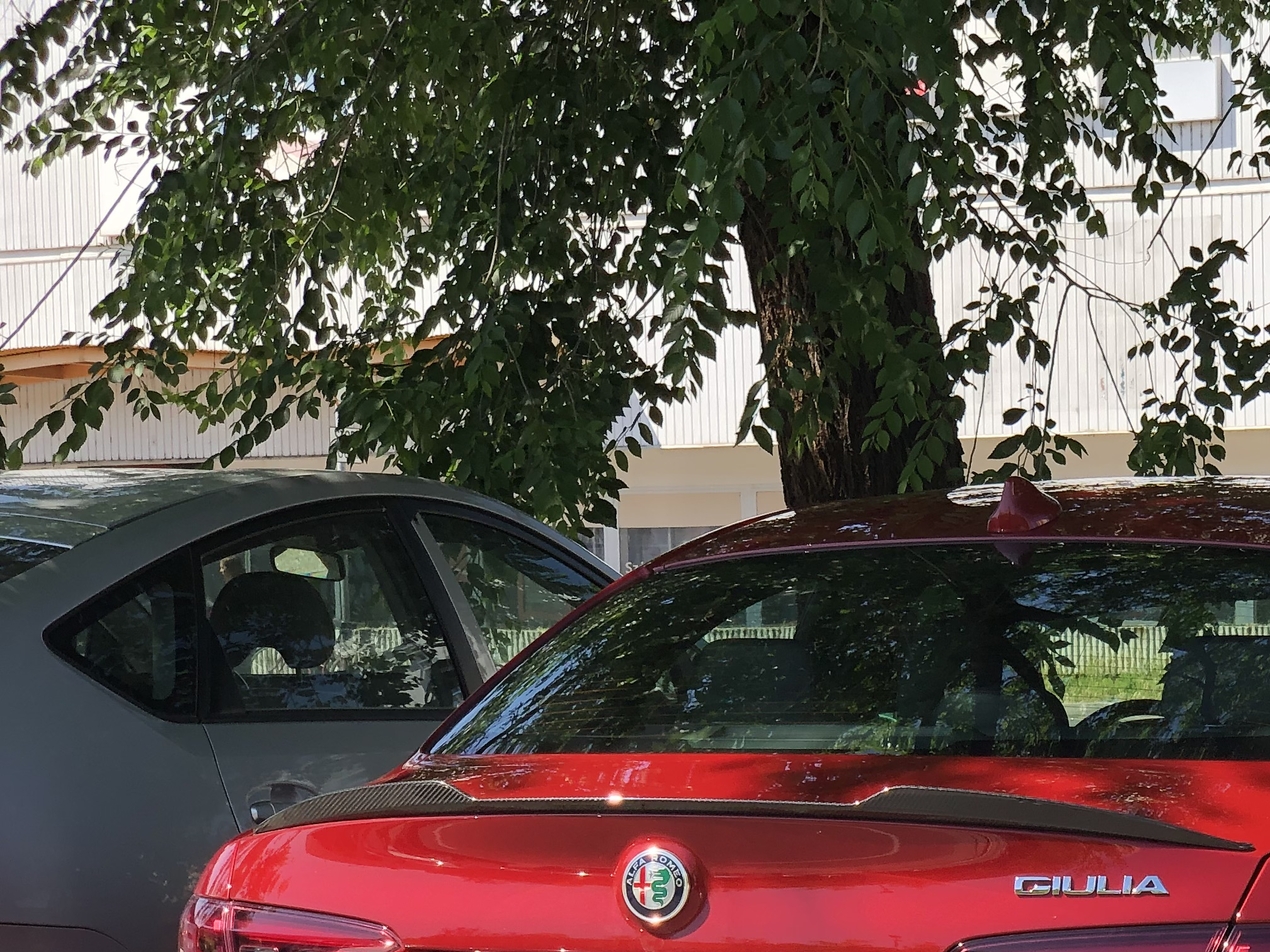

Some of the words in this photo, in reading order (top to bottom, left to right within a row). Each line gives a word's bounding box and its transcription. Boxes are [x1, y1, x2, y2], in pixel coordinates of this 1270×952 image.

[626, 857, 646, 886] ALFA
[651, 854, 683, 888] ROMEO
[1014, 875, 1169, 896] GIULIA
